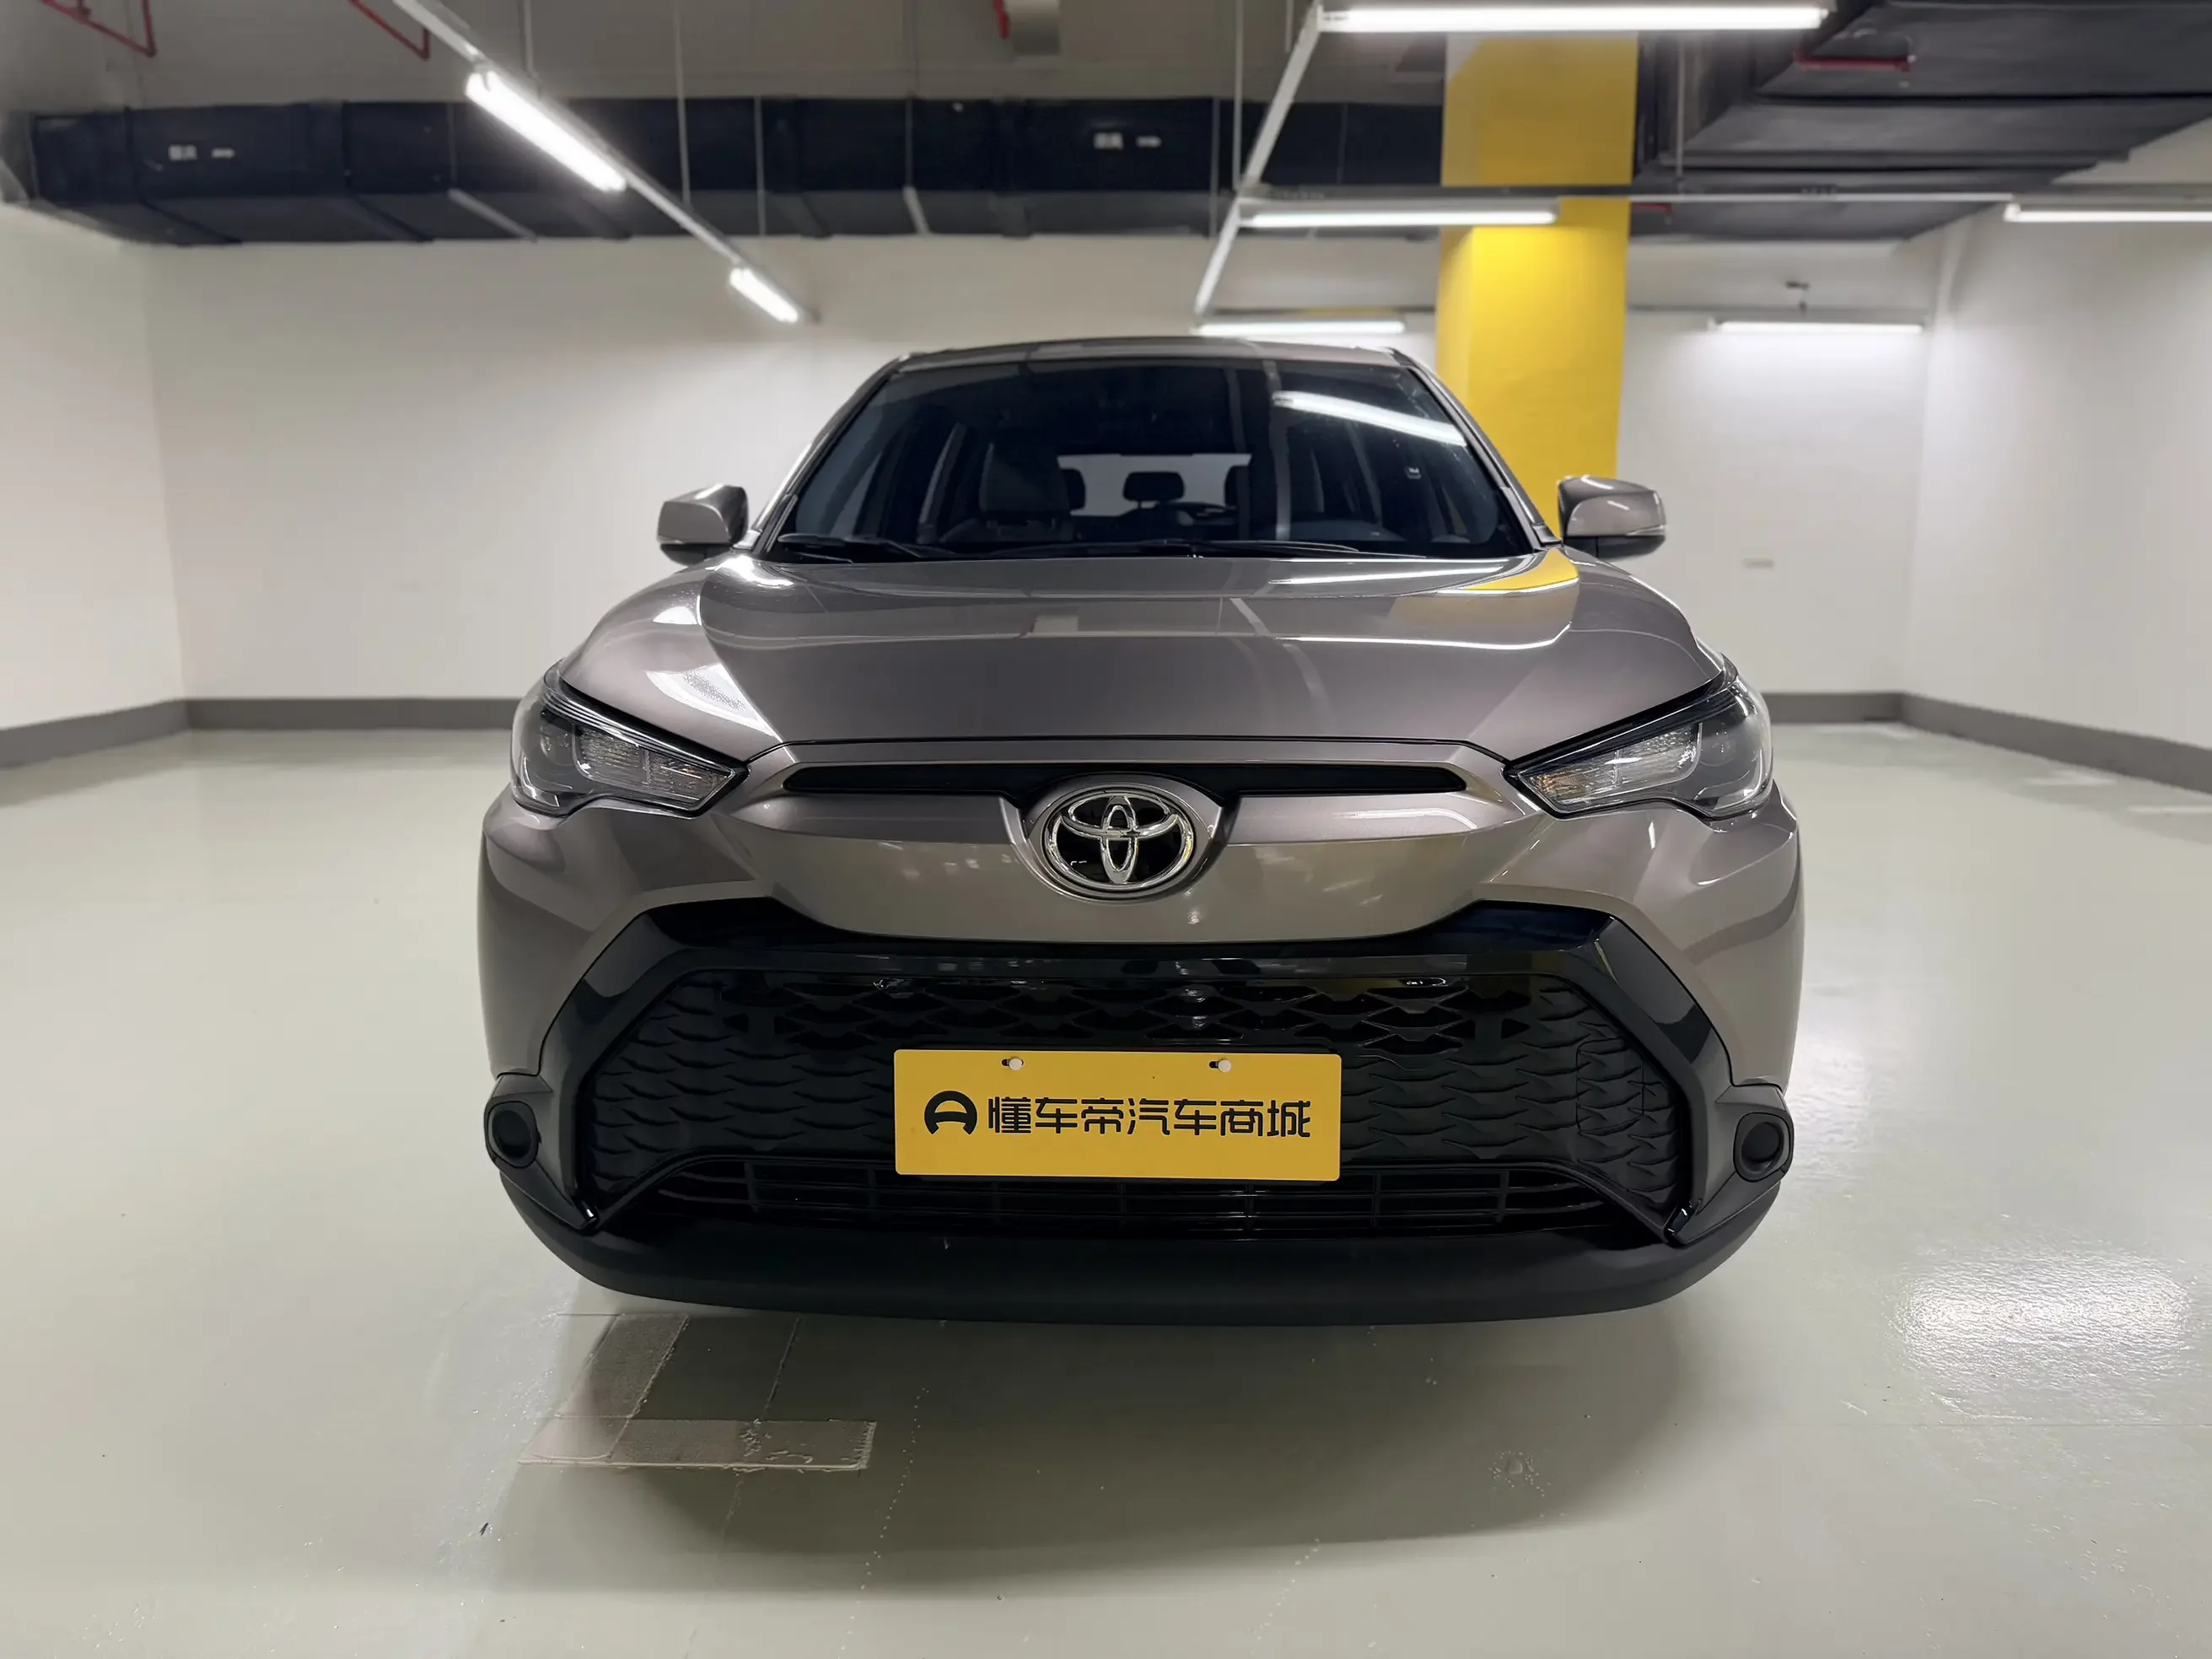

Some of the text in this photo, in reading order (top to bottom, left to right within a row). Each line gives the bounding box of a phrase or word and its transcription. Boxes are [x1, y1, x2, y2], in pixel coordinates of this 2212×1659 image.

[988, 1096, 1311, 1138] 懂车帝汽车商城
